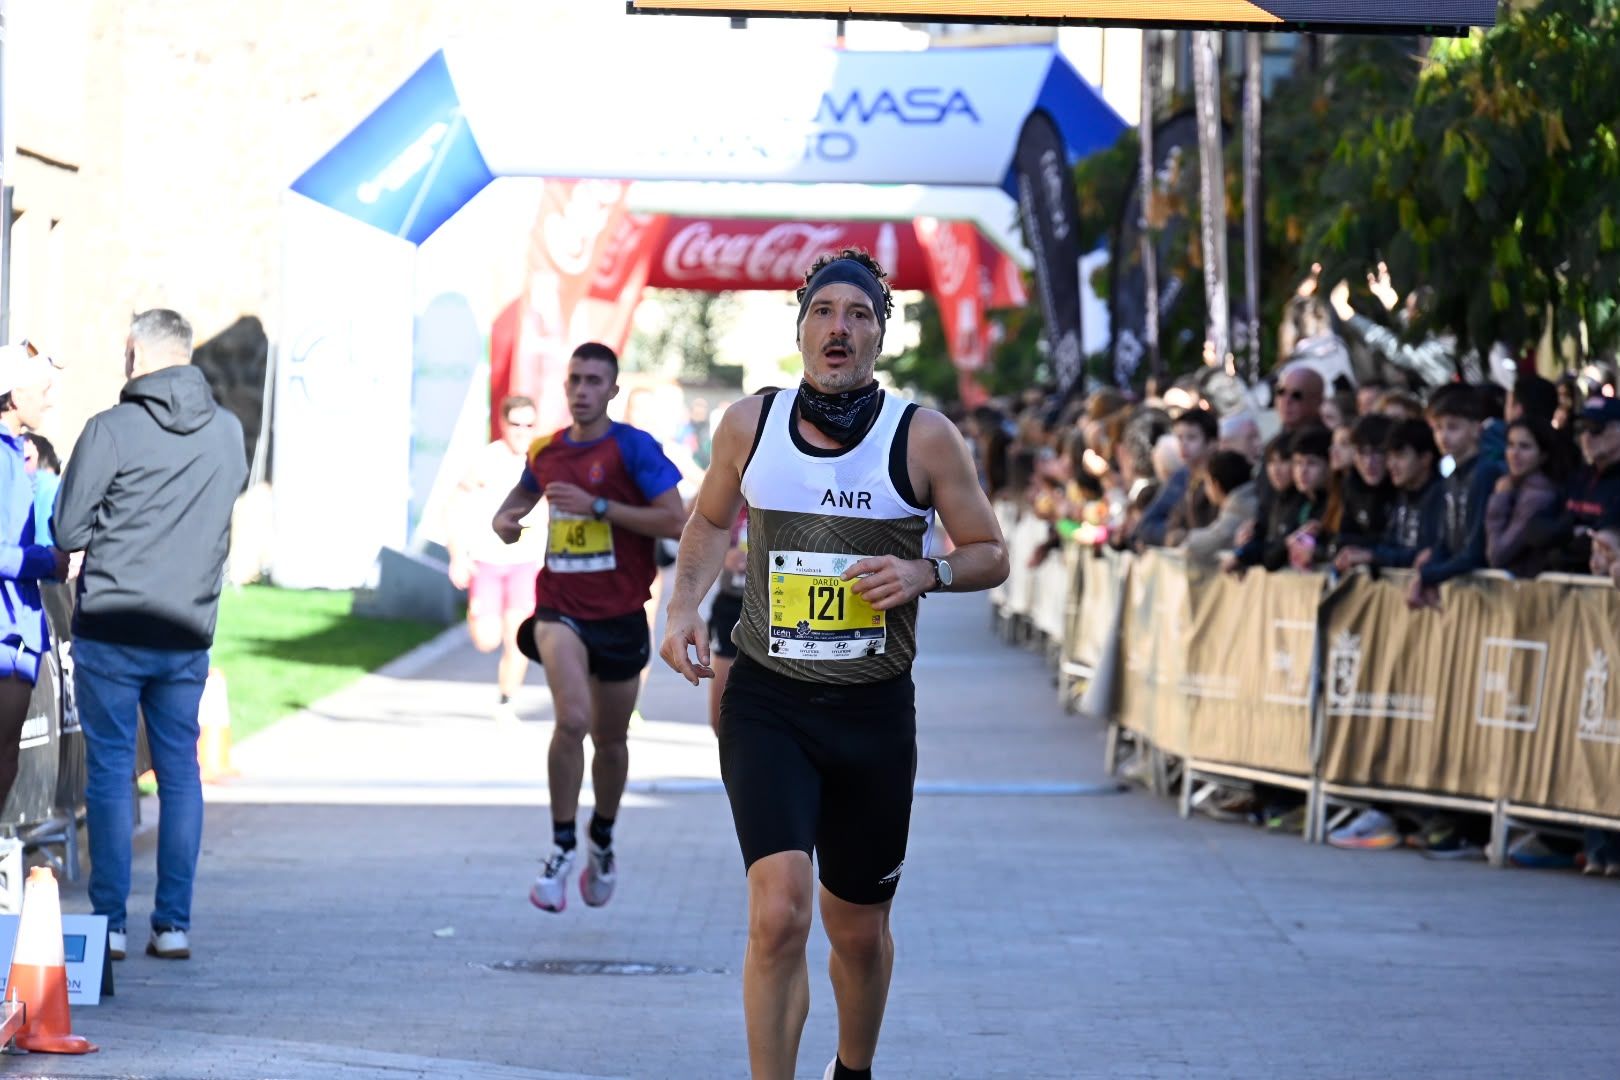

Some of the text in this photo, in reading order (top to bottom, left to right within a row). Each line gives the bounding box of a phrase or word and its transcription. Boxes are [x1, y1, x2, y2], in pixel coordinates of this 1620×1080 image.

[820, 488, 872, 510] ANR
[565, 524, 586, 548] 48
[807, 585, 845, 621] 121
